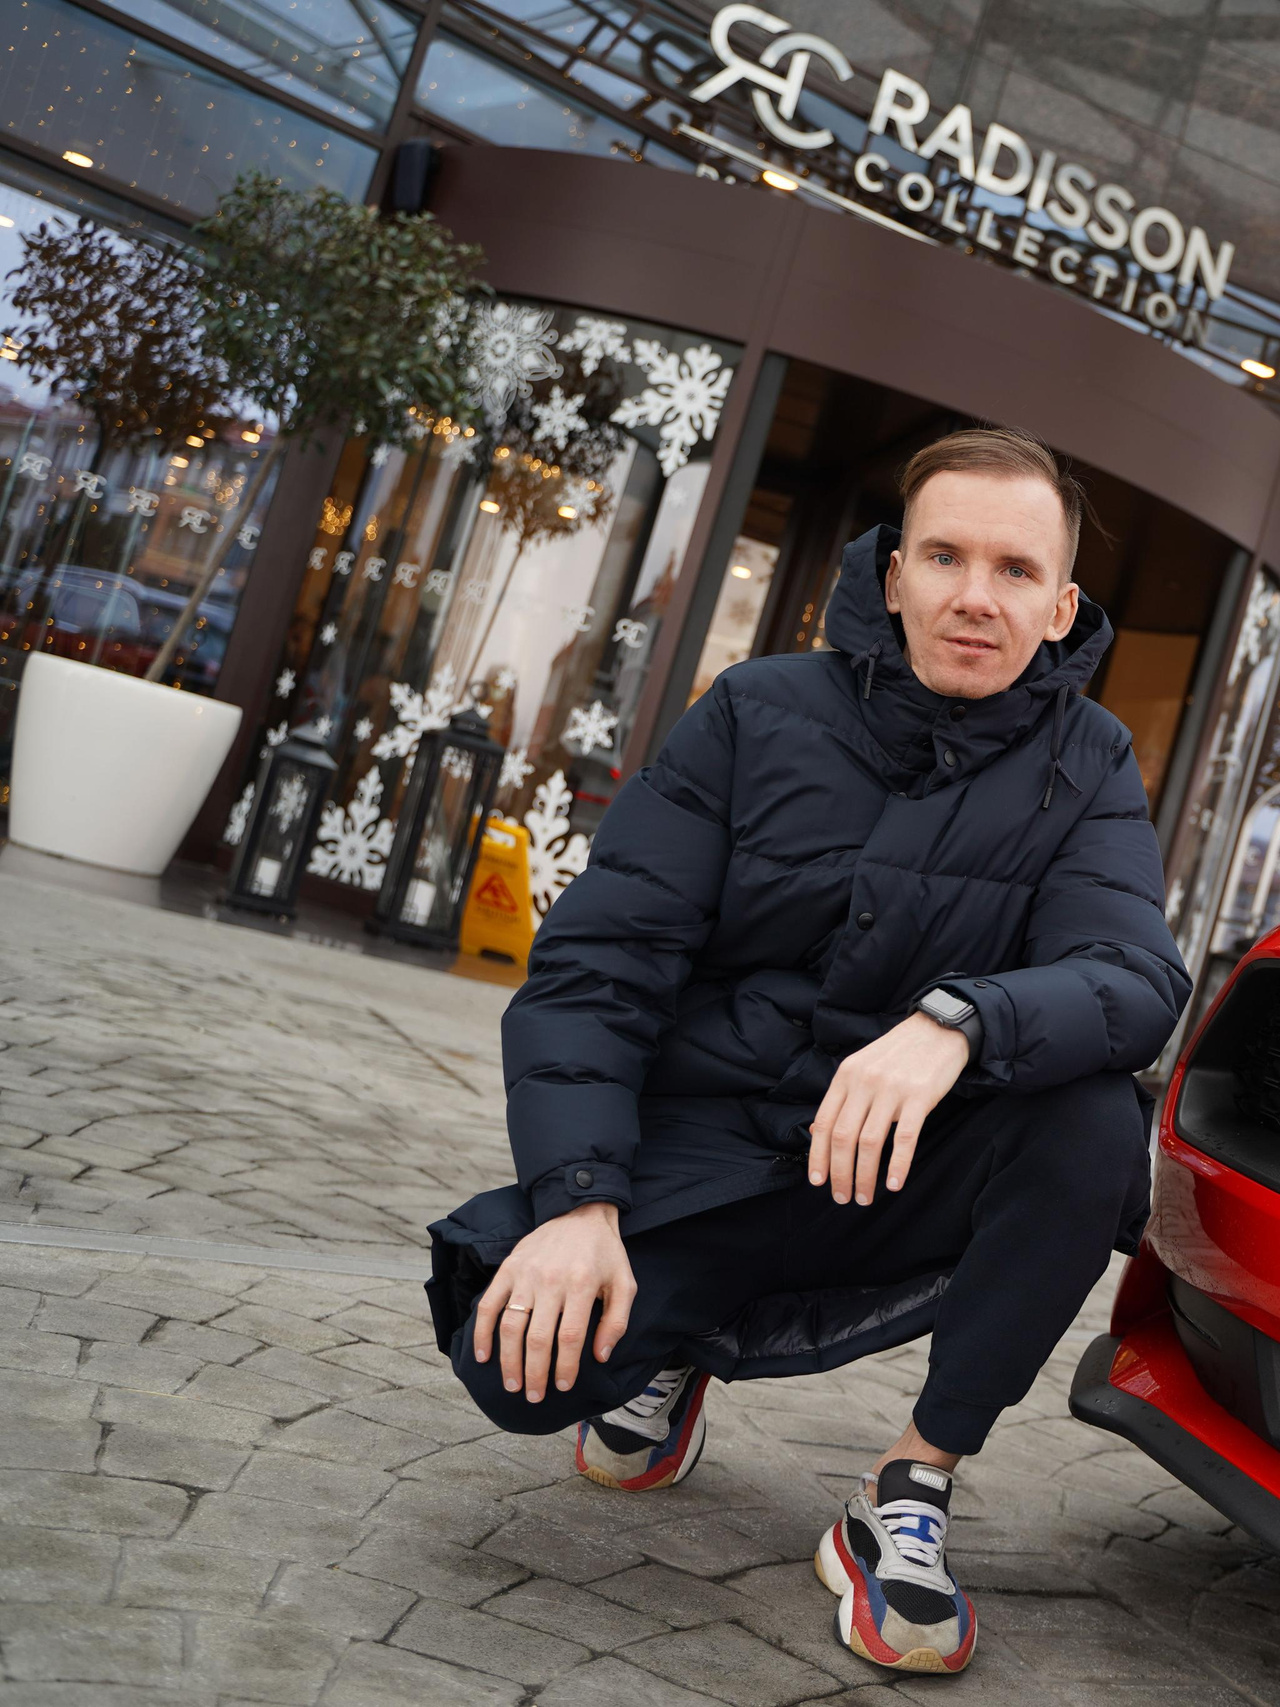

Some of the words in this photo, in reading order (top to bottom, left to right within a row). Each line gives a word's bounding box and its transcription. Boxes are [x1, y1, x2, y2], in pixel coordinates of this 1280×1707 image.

[854, 152, 1208, 343] COLLECTION
[868, 67, 1235, 300] RADISSON
[914, 1468, 944, 1487] PUMA
